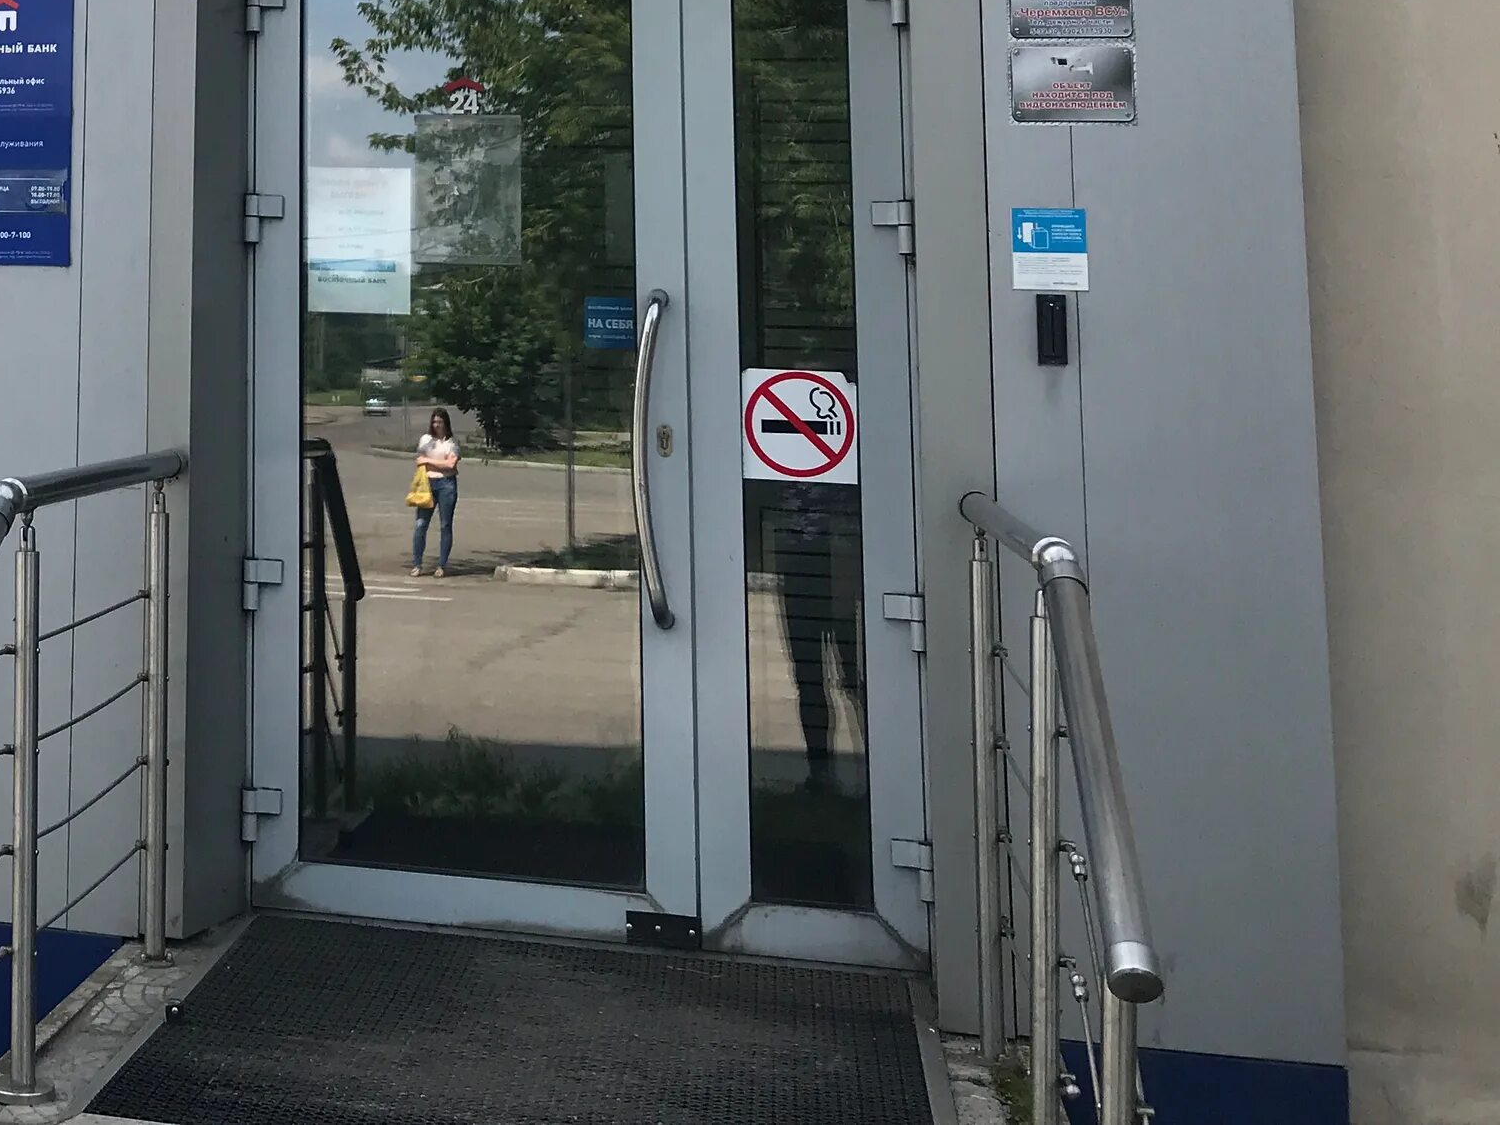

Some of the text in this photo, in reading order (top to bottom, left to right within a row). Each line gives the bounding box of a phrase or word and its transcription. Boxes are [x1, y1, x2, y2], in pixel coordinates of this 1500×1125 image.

[27, 43, 58, 54] БАНК
[25, 77, 45, 86] офис
[1052, 81, 1092, 90] ОБЪЕКТ
[1032, 91, 1114, 101] НАХОДИТСЯ ПОД
[449, 93, 480, 115] 24
[1019, 101, 1127, 110] ВИДЕОНАБЛЮДЕНИЕМ
[587, 318, 634, 330] НА СЕБЯ
